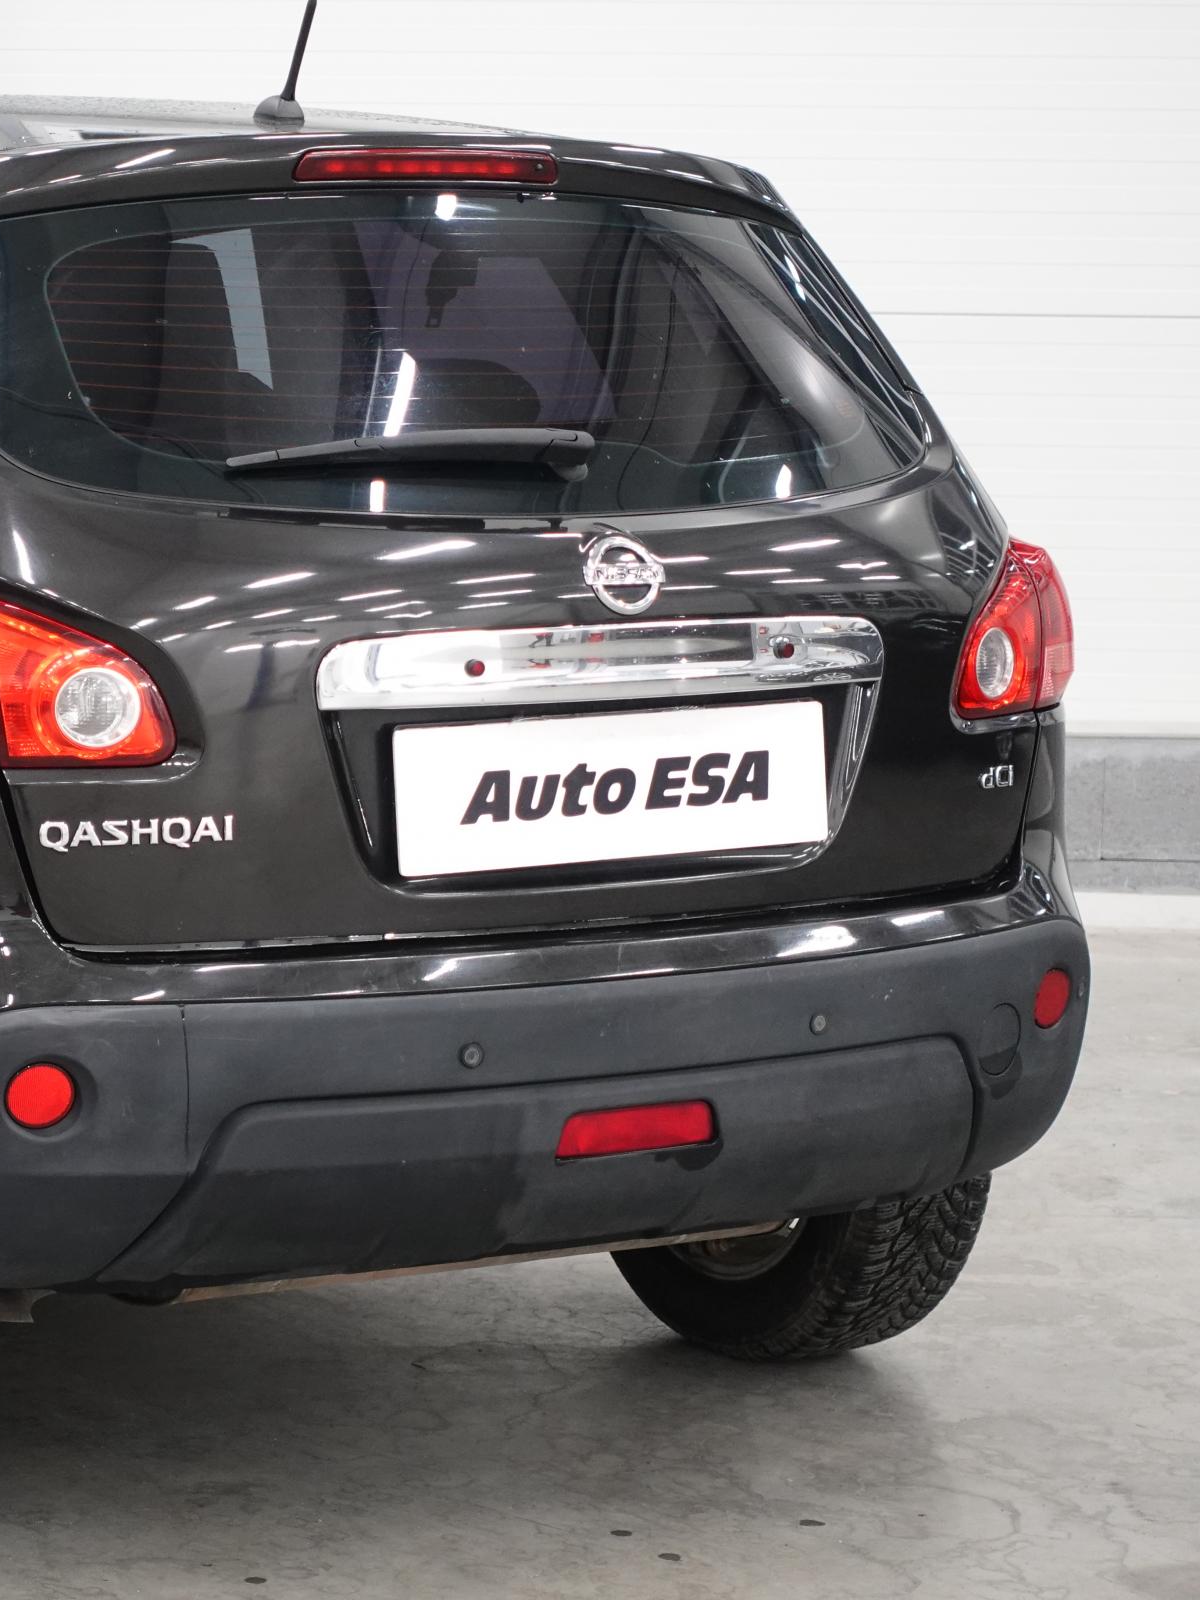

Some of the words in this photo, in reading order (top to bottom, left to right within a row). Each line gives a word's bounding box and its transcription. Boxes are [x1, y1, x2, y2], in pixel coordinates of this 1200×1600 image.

[460, 763, 636, 825] Auto
[644, 750, 769, 810] ESA
[39, 814, 234, 852] QASHQAI
